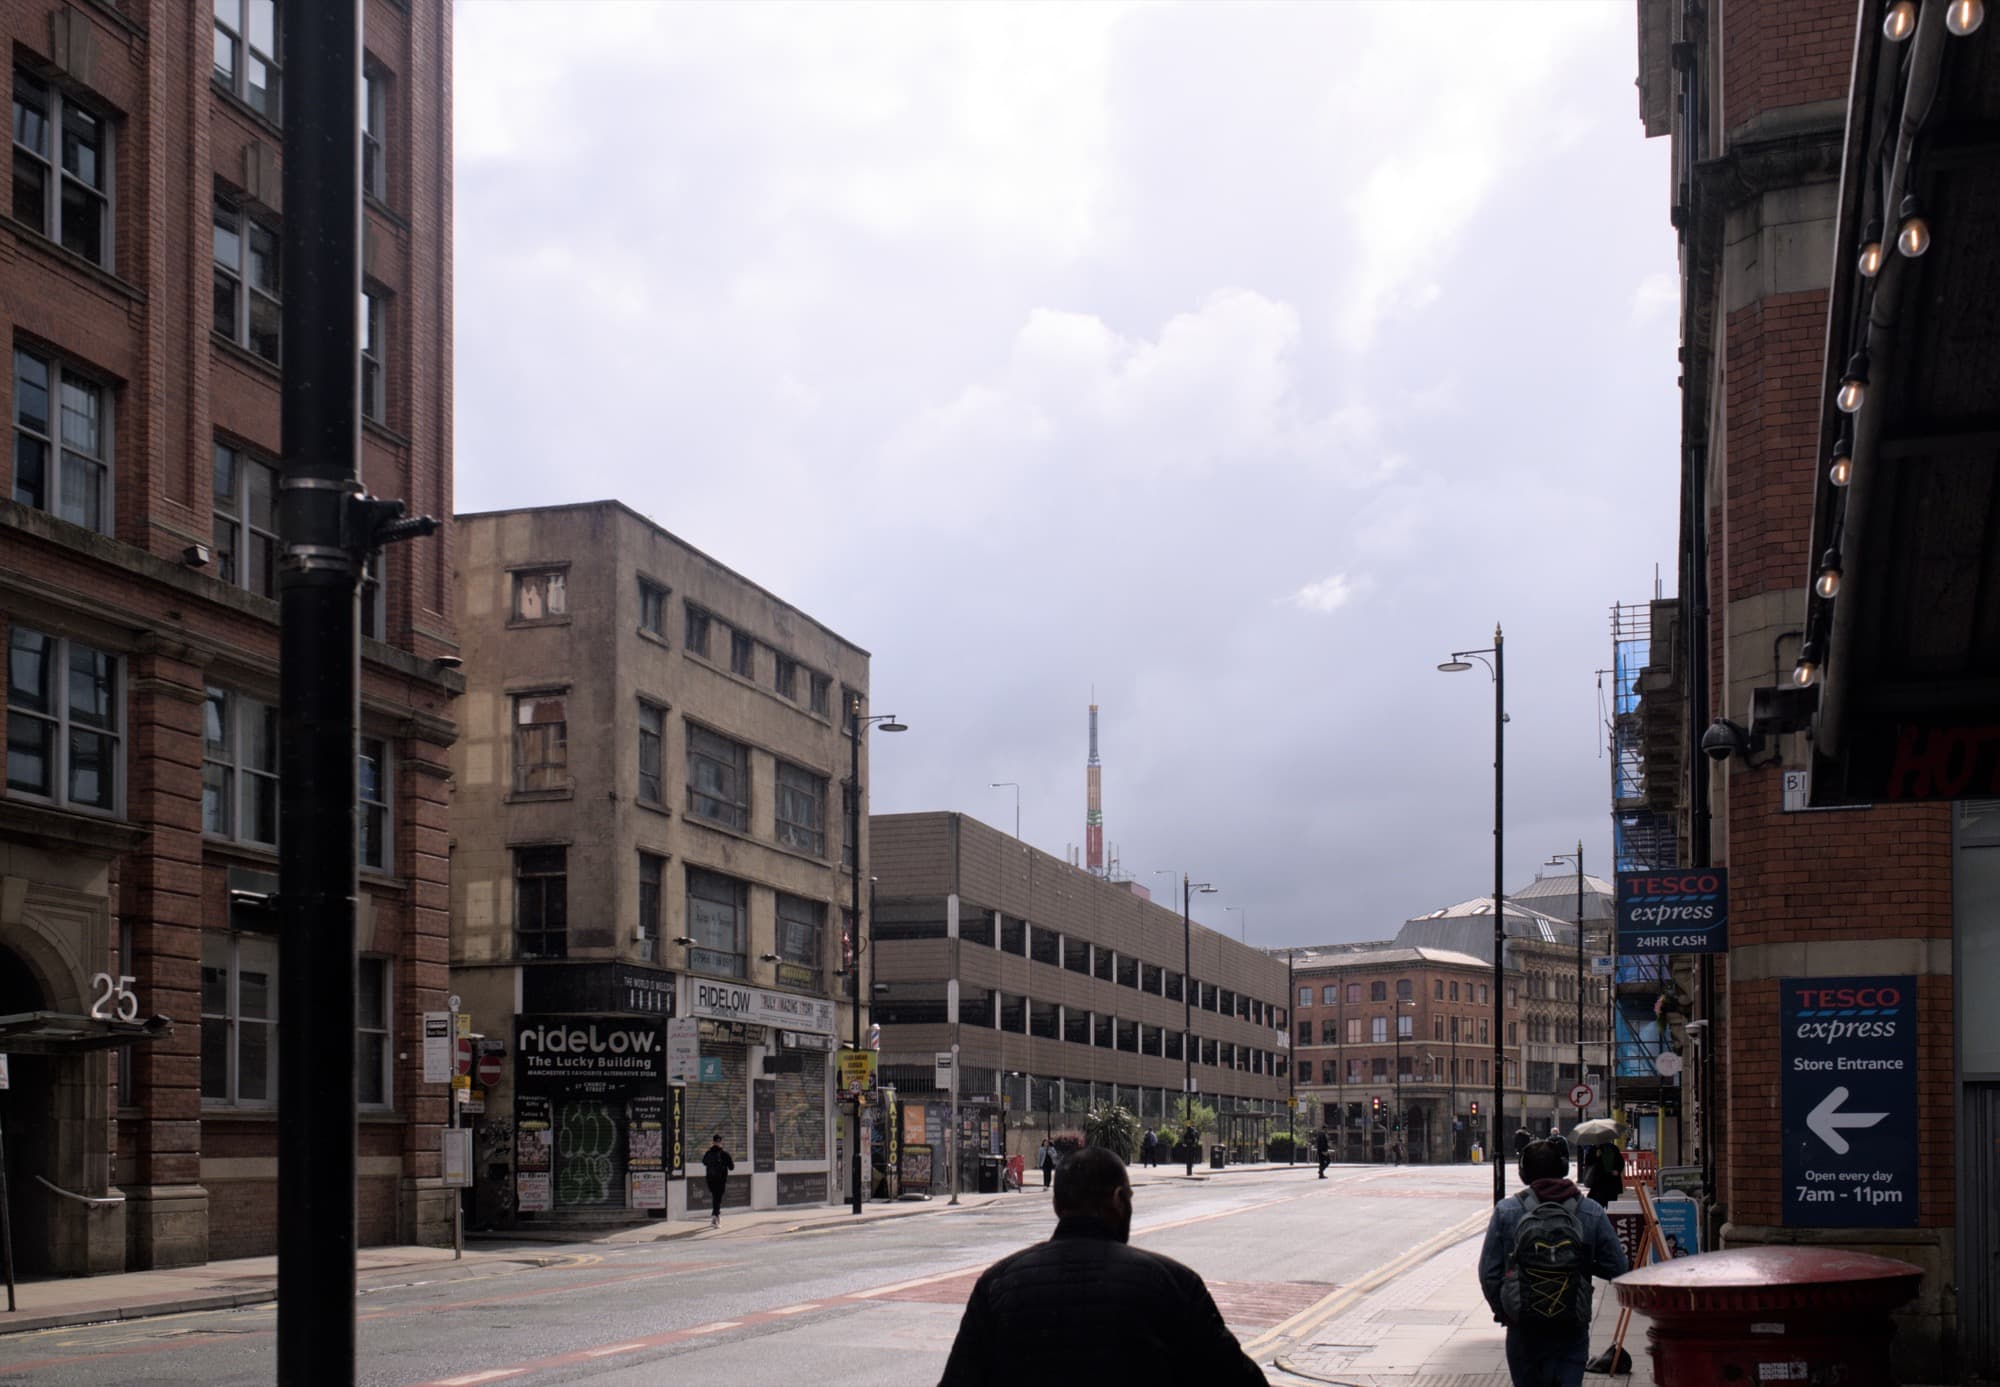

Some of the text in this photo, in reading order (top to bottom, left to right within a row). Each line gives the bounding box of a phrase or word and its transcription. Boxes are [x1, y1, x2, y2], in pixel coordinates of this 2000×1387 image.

[1626, 875, 1719, 895] TESCO
[1630, 902, 1713, 925] express
[1636, 935, 1707, 947] 24HR CASH
[90, 972, 139, 1022] 25
[699, 985, 751, 1013] RIDELOW
[1795, 988, 1901, 1009] TESCO
[1796, 1020, 1896, 1045] express
[528, 1056, 652, 1069] The Lucky Building
[1793, 1057, 1904, 1071] Store Entrance
[673, 1088, 681, 1168] TATTOO
[886, 1091, 897, 1165] TATTOO
[1804, 1169, 1893, 1184] Open every day
[1796, 1187, 1835, 1203] 7am
[1853, 1186, 1903, 1205] 11pm
[1616, 1217, 1630, 1258] OSTA
